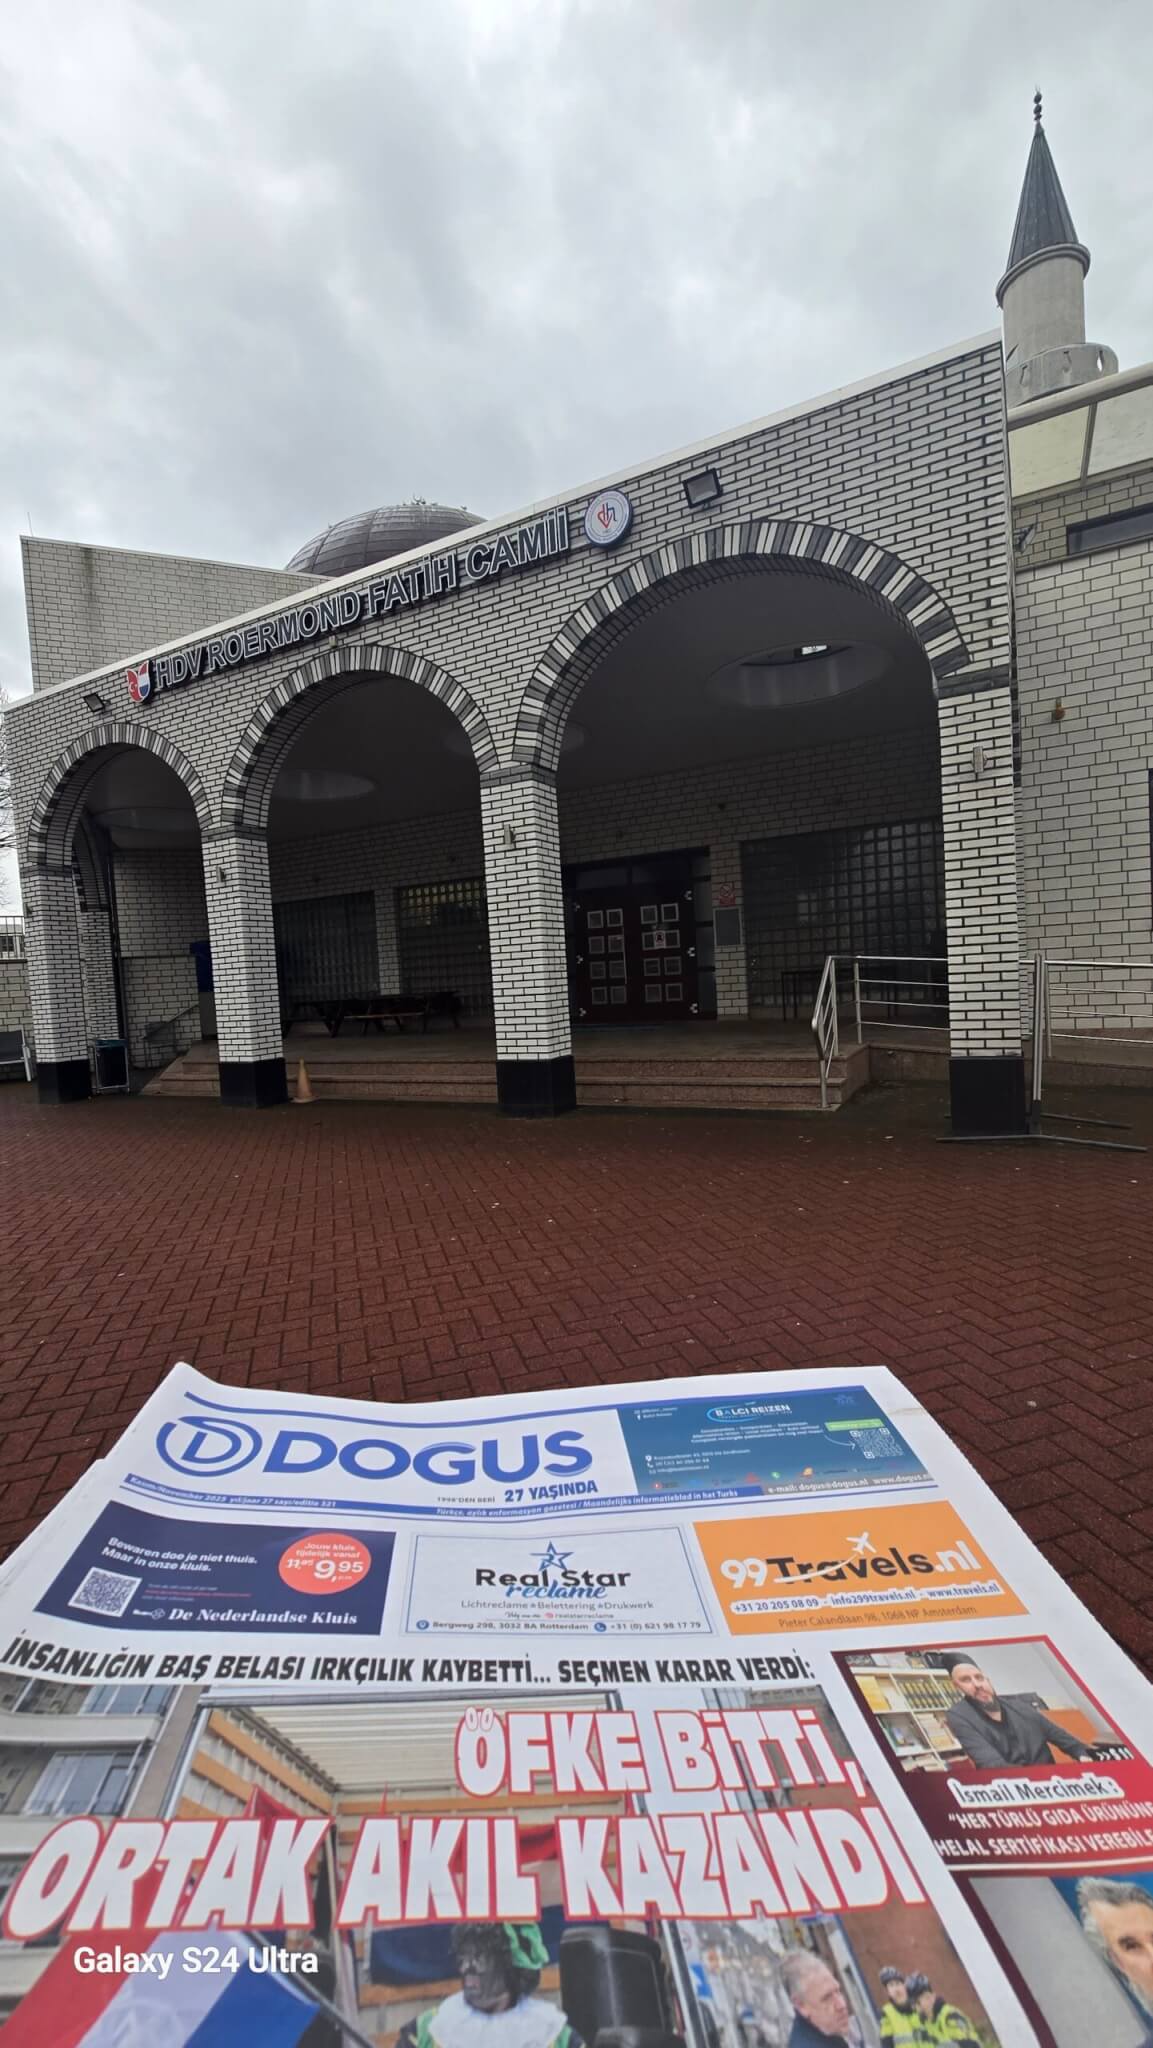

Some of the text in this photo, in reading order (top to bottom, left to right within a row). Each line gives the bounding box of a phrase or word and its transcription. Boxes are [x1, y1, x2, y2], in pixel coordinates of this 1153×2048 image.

[156, 649, 203, 689] HDV
[206, 590, 361, 671] ROERMOND
[368, 551, 457, 616] FATİH
[465, 506, 570, 581] CAMİİ
[262, 1430, 593, 1486] DOGUS
[504, 1480, 599, 1503] 27 YAŞINDA
[102, 1547, 213, 1572] Maar in onze kluis.
[108, 1537, 258, 1564] Bewaren doe je niet thuis.
[475, 1567, 632, 1588] Real Star
[504, 1580, 608, 1600] reclame
[168, 1608, 358, 1625] De Nederlandse Kluis
[735, 1602, 754, 1613] +31
[755, 1601, 769, 1611] 20
[771, 1599, 791, 1610] 205
[806, 1597, 819, 1607] 09
[0, 1628, 155, 1680] İNSANLIĞIN
[155, 1653, 212, 1683] BAŞ
[214, 1654, 306, 1682] BELASI
[309, 1656, 414, 1685] IRKÇILIK
[558, 1658, 653, 1687] SEÇMEN
[657, 1658, 736, 1684] KARAR
[455, 1706, 652, 1798] ÖFKE
[1015, 1776, 1106, 1801] Mercimek
[990, 1807, 1042, 1829] TÜRLÜ
[1042, 1807, 1086, 1827] GIDA
[933, 1839, 990, 1857] HELAL
[988, 1834, 1085, 1857] SERTİFİKASI
[2, 1806, 930, 1940] ORTAK AKIL KAZANDI
